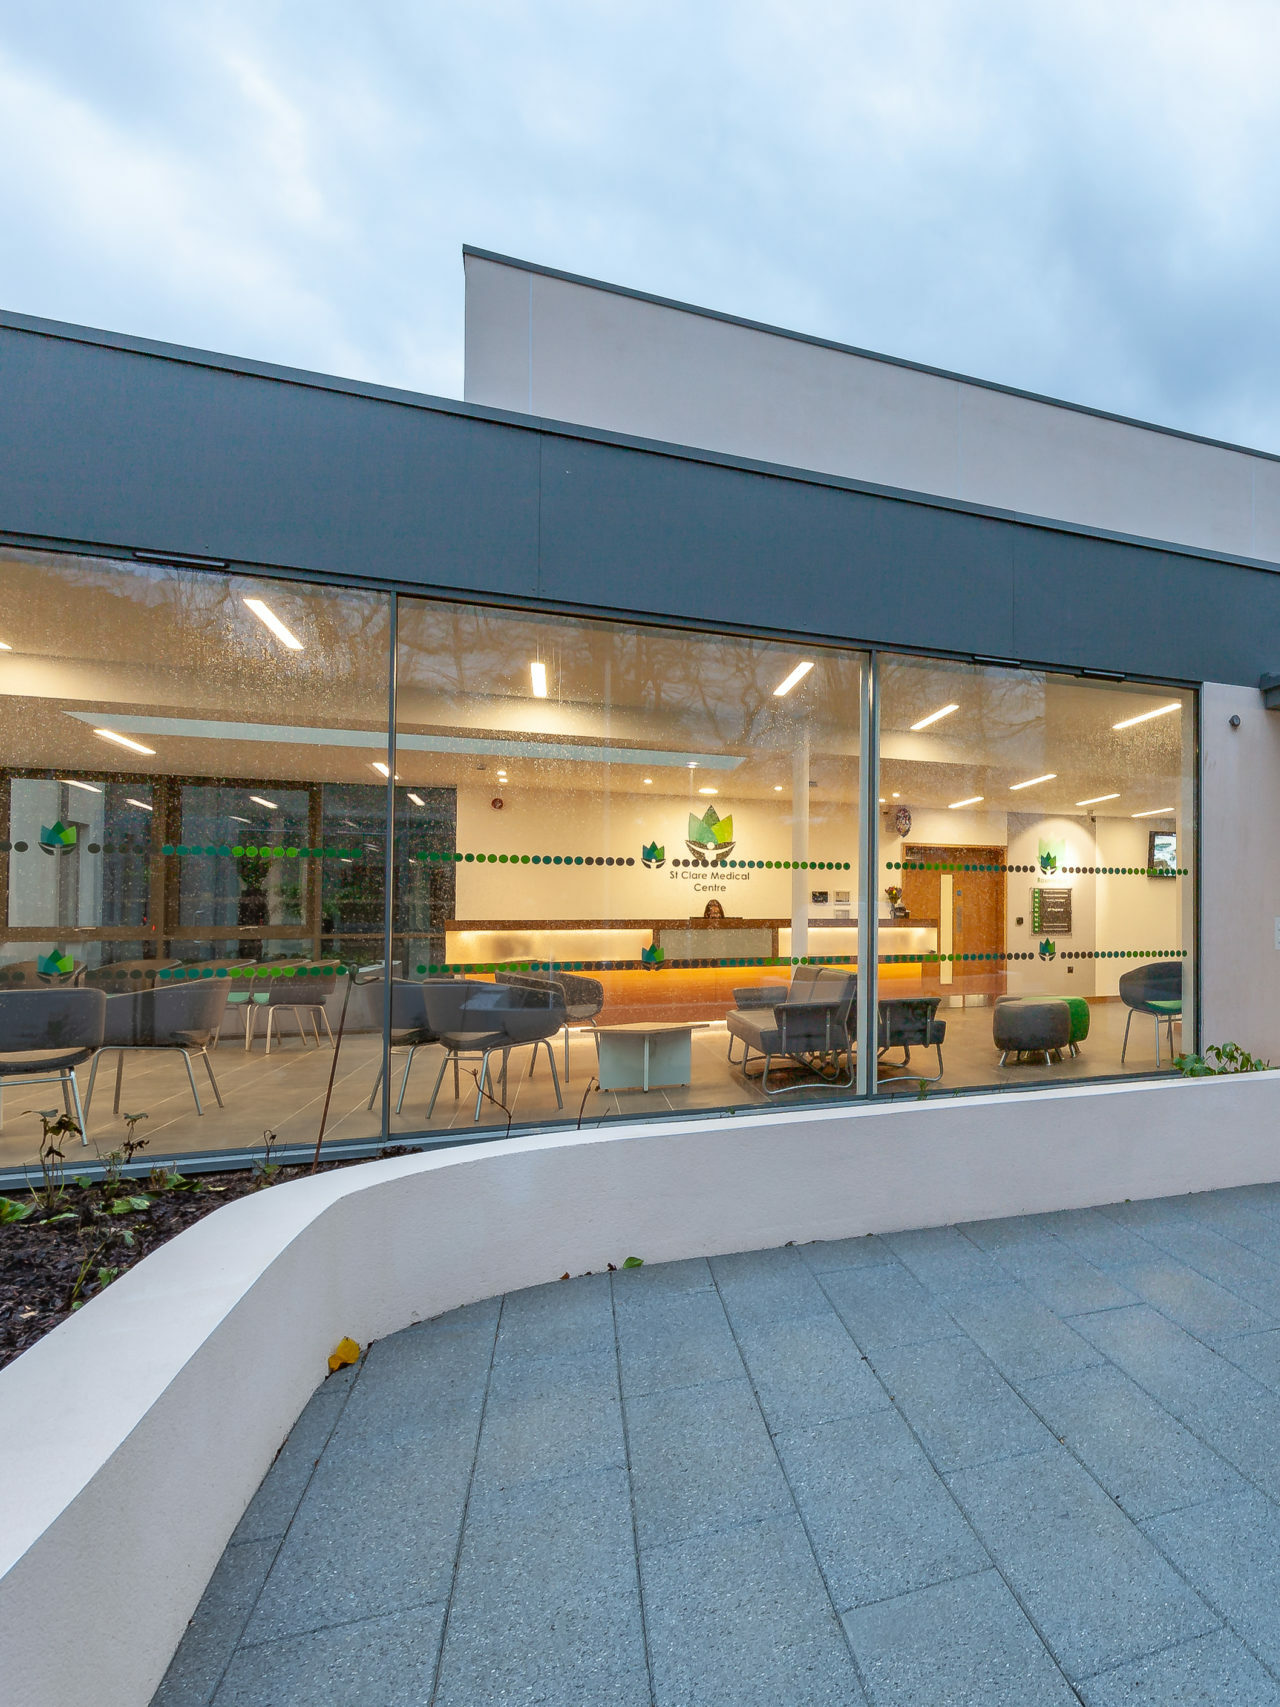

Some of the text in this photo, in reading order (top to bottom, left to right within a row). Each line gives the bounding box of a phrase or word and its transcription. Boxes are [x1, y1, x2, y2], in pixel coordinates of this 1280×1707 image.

[669, 871, 750, 880] St Clare Medical
[693, 883, 727, 892] Centre
